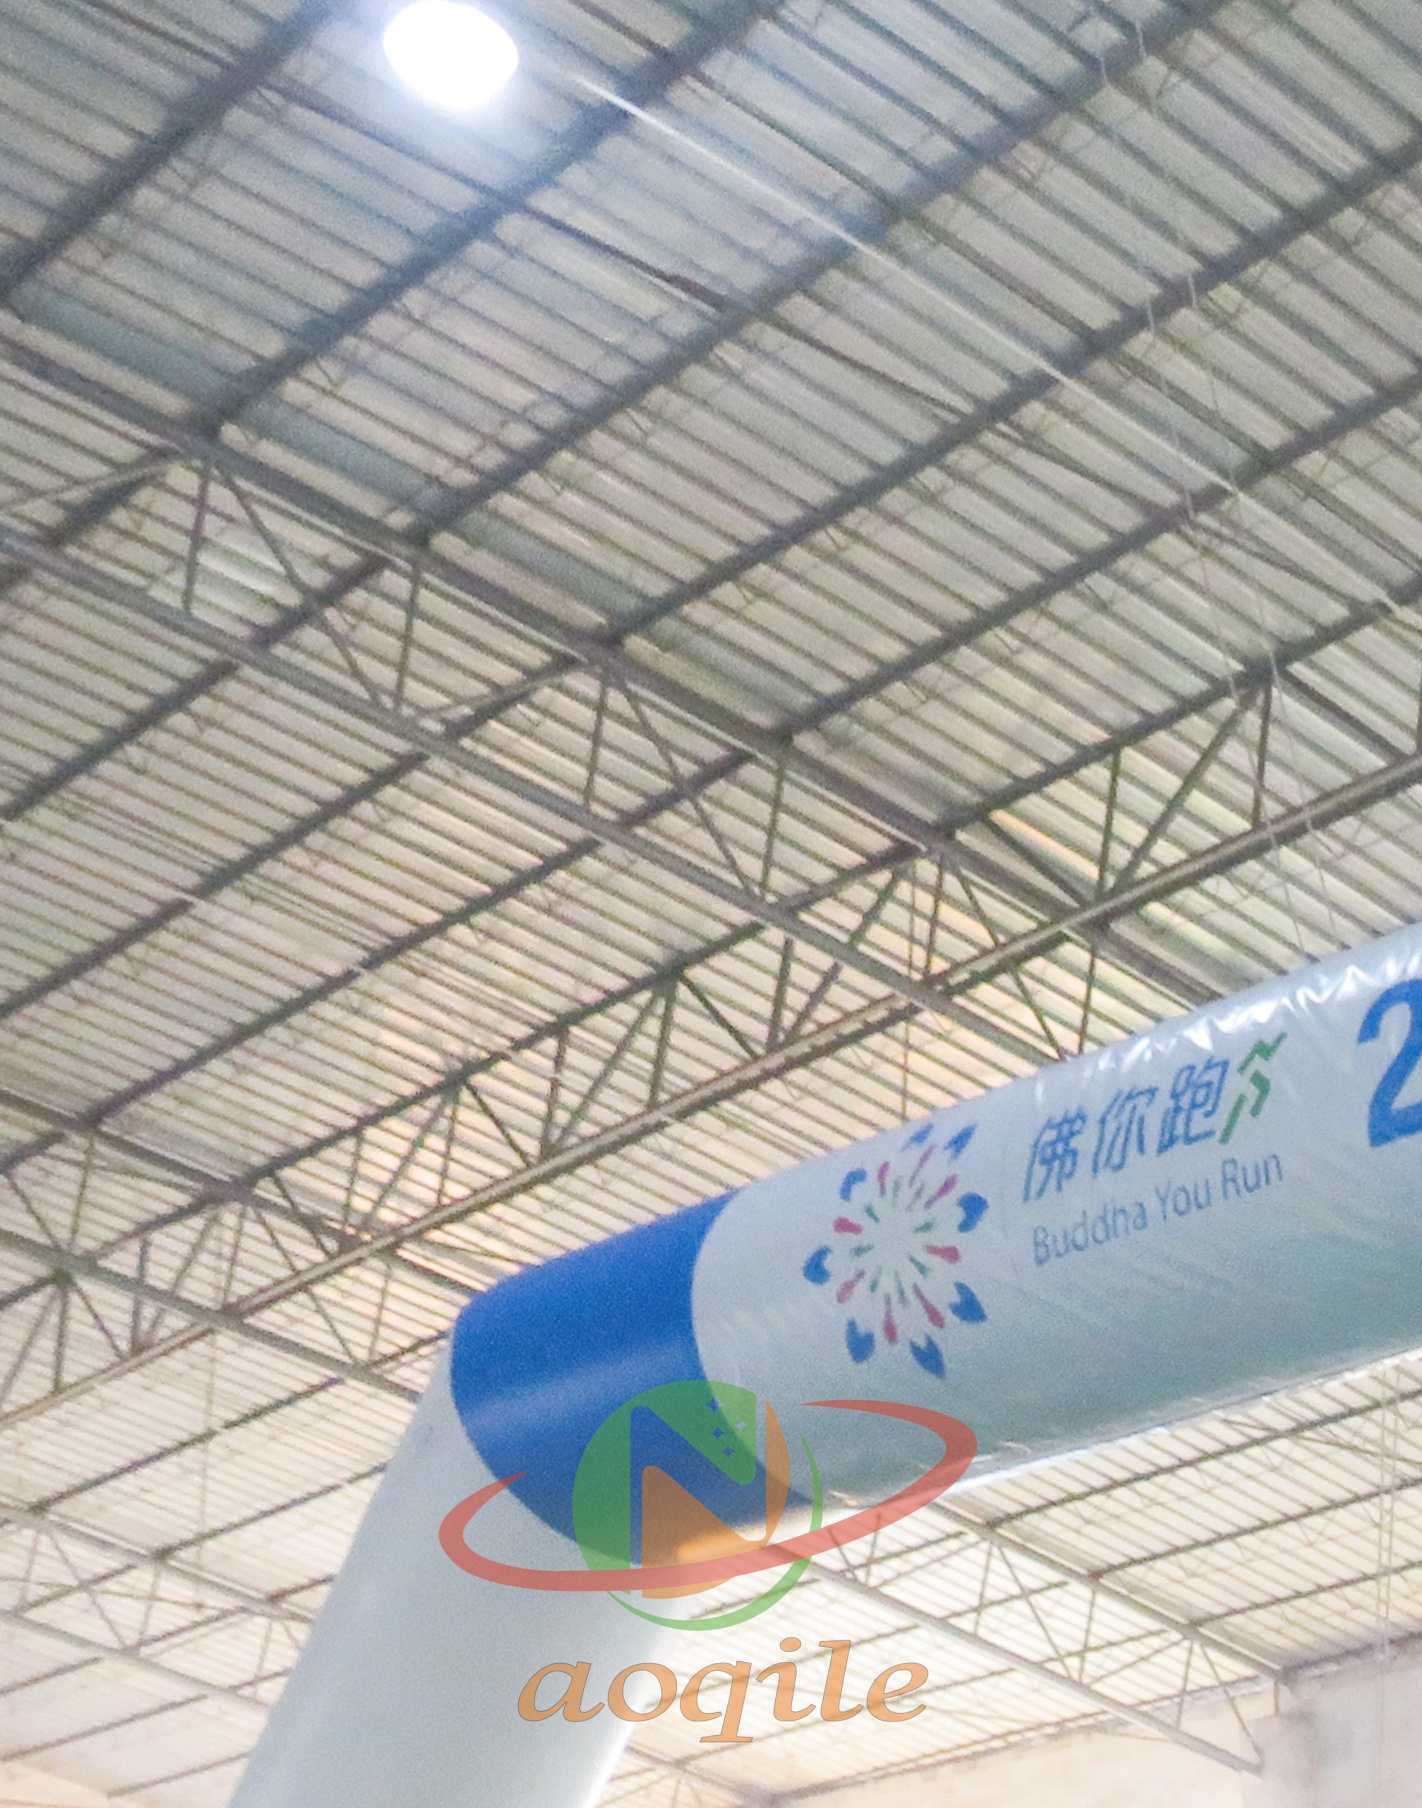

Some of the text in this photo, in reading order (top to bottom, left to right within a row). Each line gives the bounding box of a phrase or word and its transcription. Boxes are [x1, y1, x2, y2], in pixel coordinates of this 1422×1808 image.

[1033, 1154, 1283, 1267] Buddha You Run
